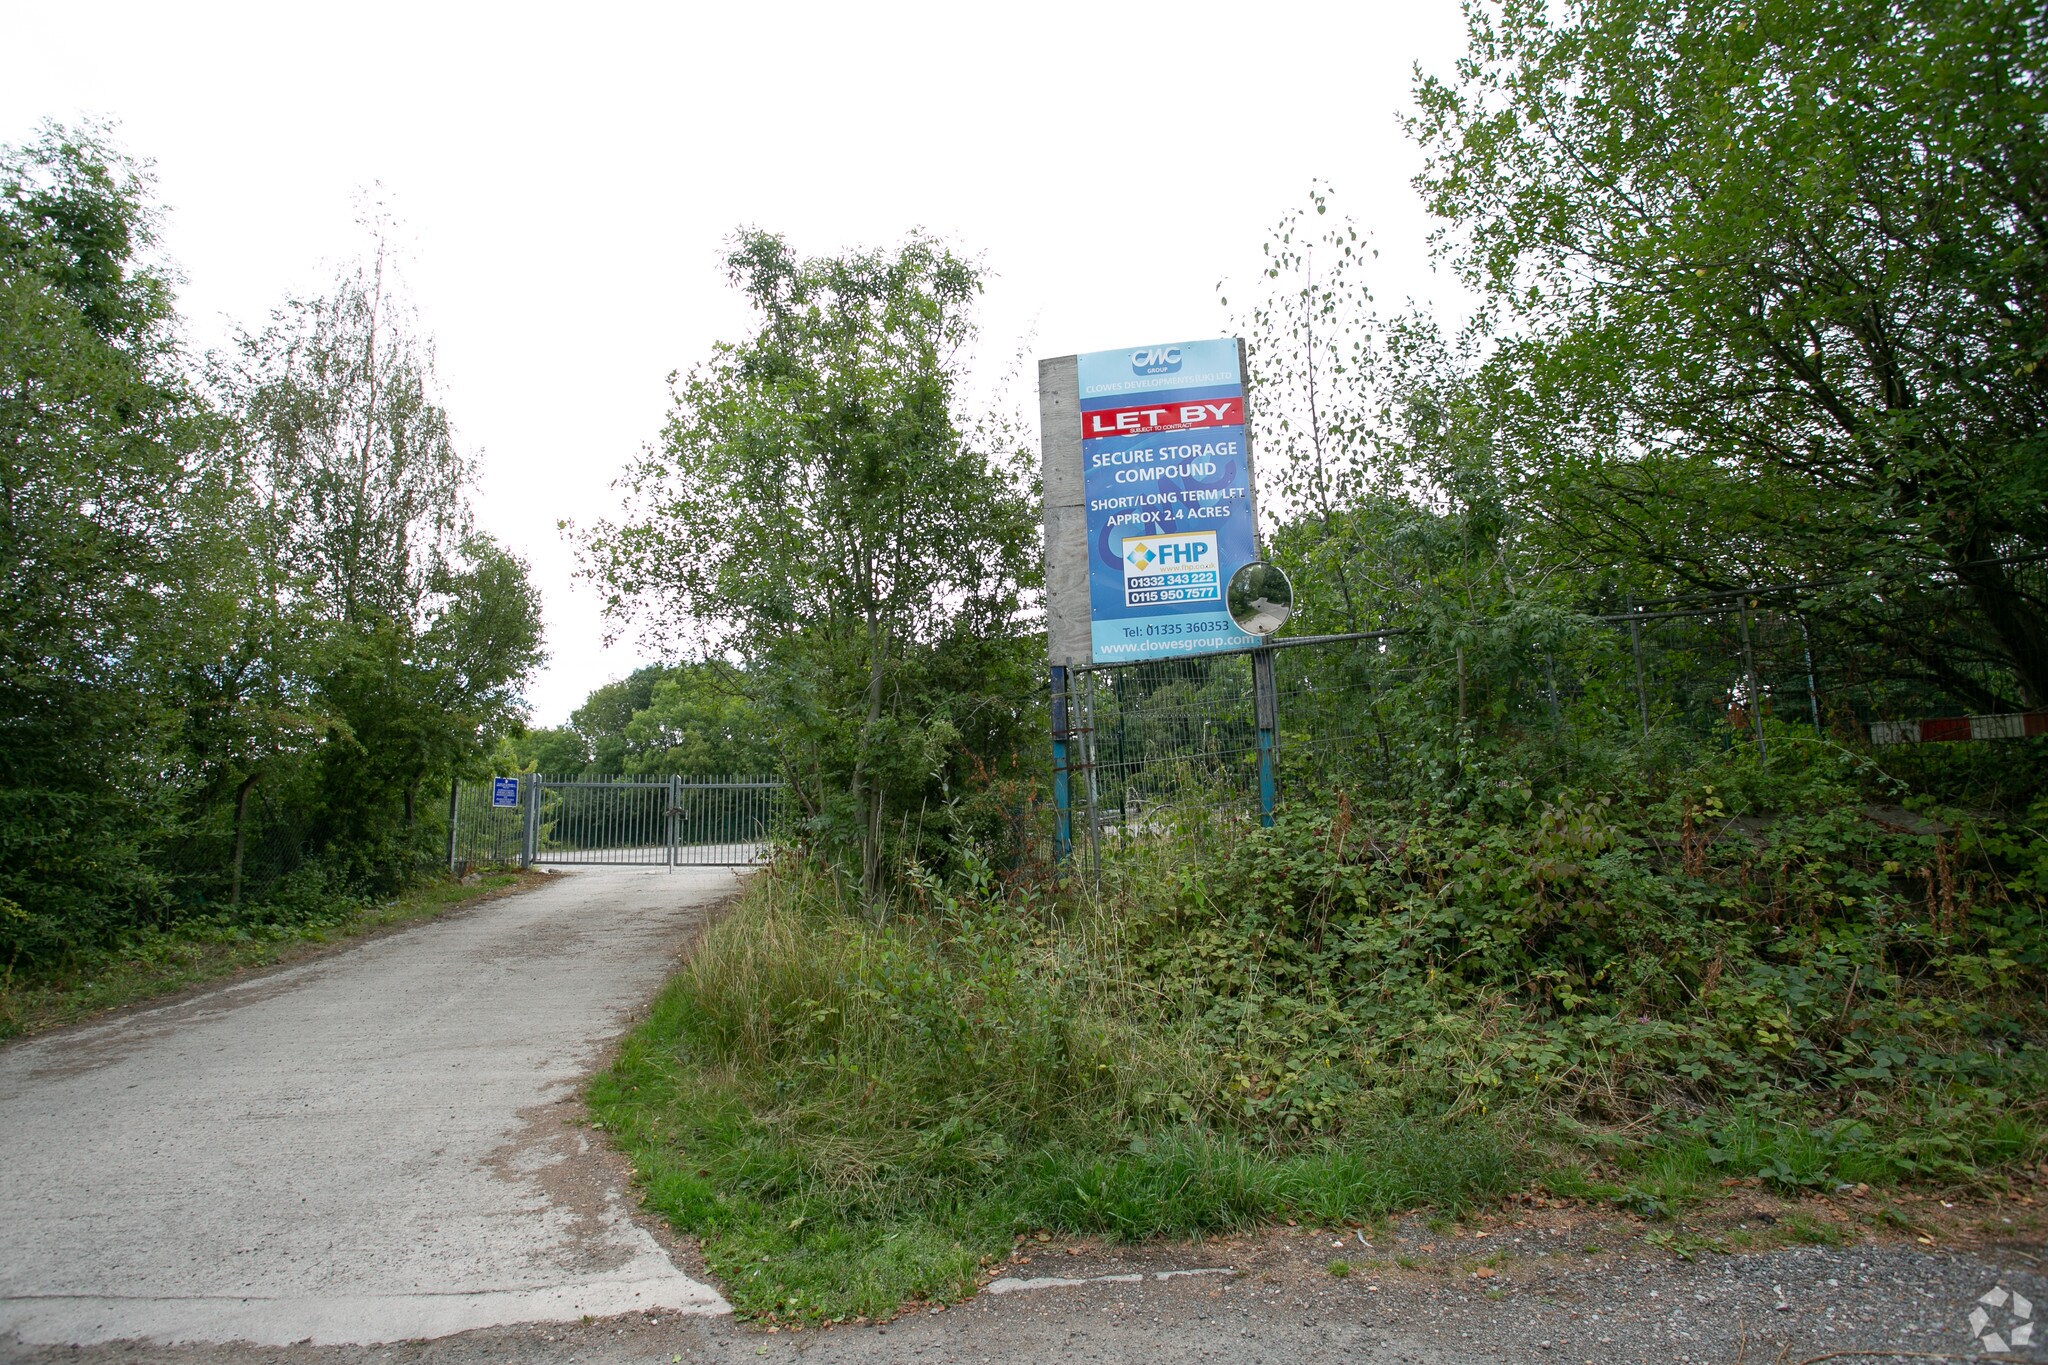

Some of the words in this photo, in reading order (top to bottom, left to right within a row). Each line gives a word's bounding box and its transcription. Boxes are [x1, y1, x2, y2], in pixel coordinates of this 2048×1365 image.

[1086, 381, 1122, 394] CLOWES
[1216, 371, 1232, 381] LTD
[1092, 409, 1167, 432] LET
[1180, 403, 1232, 423] BY
[1129, 426, 1153, 434] SUBJECT
[1162, 422, 1193, 430] CONTRACT
[1092, 448, 1154, 468] SECURE
[1159, 441, 1238, 461] STORAGE
[1115, 462, 1217, 484] COMPOUND
[1090, 491, 1177, 511] SHORT/LONG
[1180, 489, 1218, 503] TERM
[1106, 510, 1161, 527] APPROX
[1164, 509, 1184, 522] 2.4
[1187, 505, 1231, 519] ACRES
[1158, 542, 1208, 565] FHP
[1159, 562, 1216, 574] www.fhp.co.uk
[1130, 576, 1166, 588] 01332
[1167, 574, 1190, 585] 343
[1191, 572, 1214, 584] 222
[1131, 591, 1158, 603] 0115
[1160, 589, 1184, 601] 950
[1185, 587, 1214, 599] 7577
[1122, 627, 1143, 638] Tel:
[1146, 624, 1182, 636] 01335
[1186, 620, 1229, 633] 360353
[1100, 635, 1254, 655] www.clowesgroup.com
